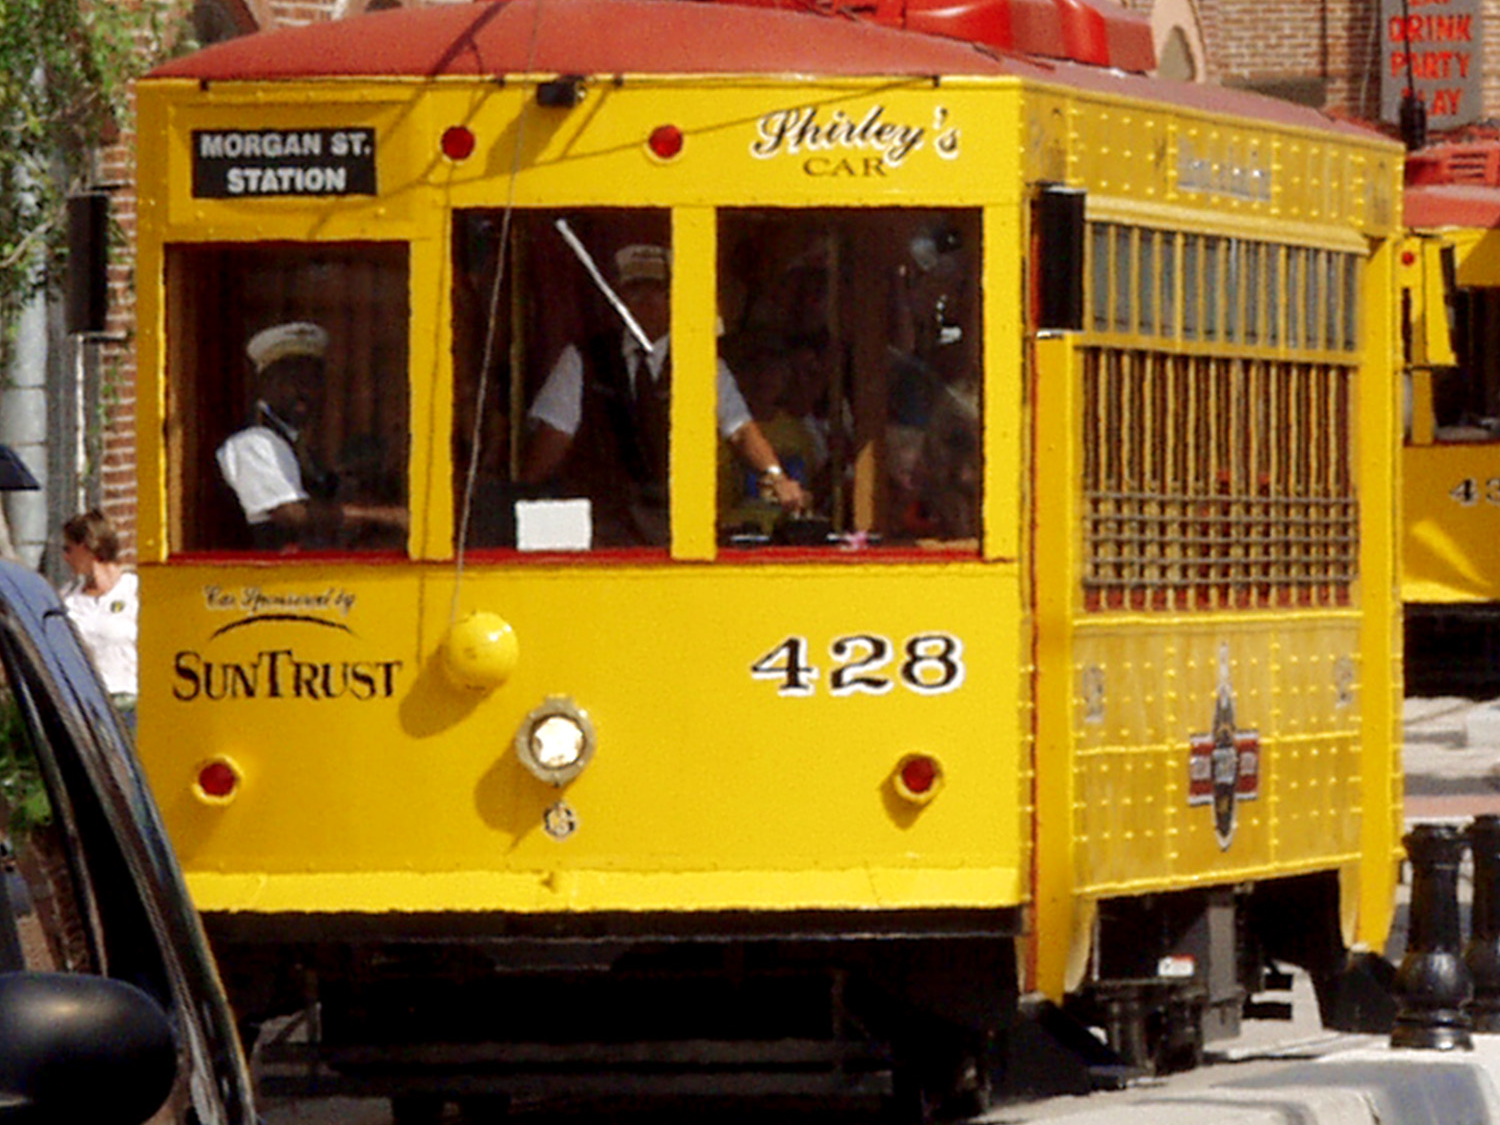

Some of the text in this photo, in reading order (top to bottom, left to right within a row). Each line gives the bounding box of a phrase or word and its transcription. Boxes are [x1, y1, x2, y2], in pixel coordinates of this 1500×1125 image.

[1387, 14, 1473, 44] DRINK
[1390, 49, 1473, 81] PARTY
[199, 131, 371, 162] MORGAN ST.
[750, 105, 961, 166] Shirley's
[227, 167, 346, 195] STATION
[802, 157, 887, 177] CAR
[751, 630, 966, 696] 428
